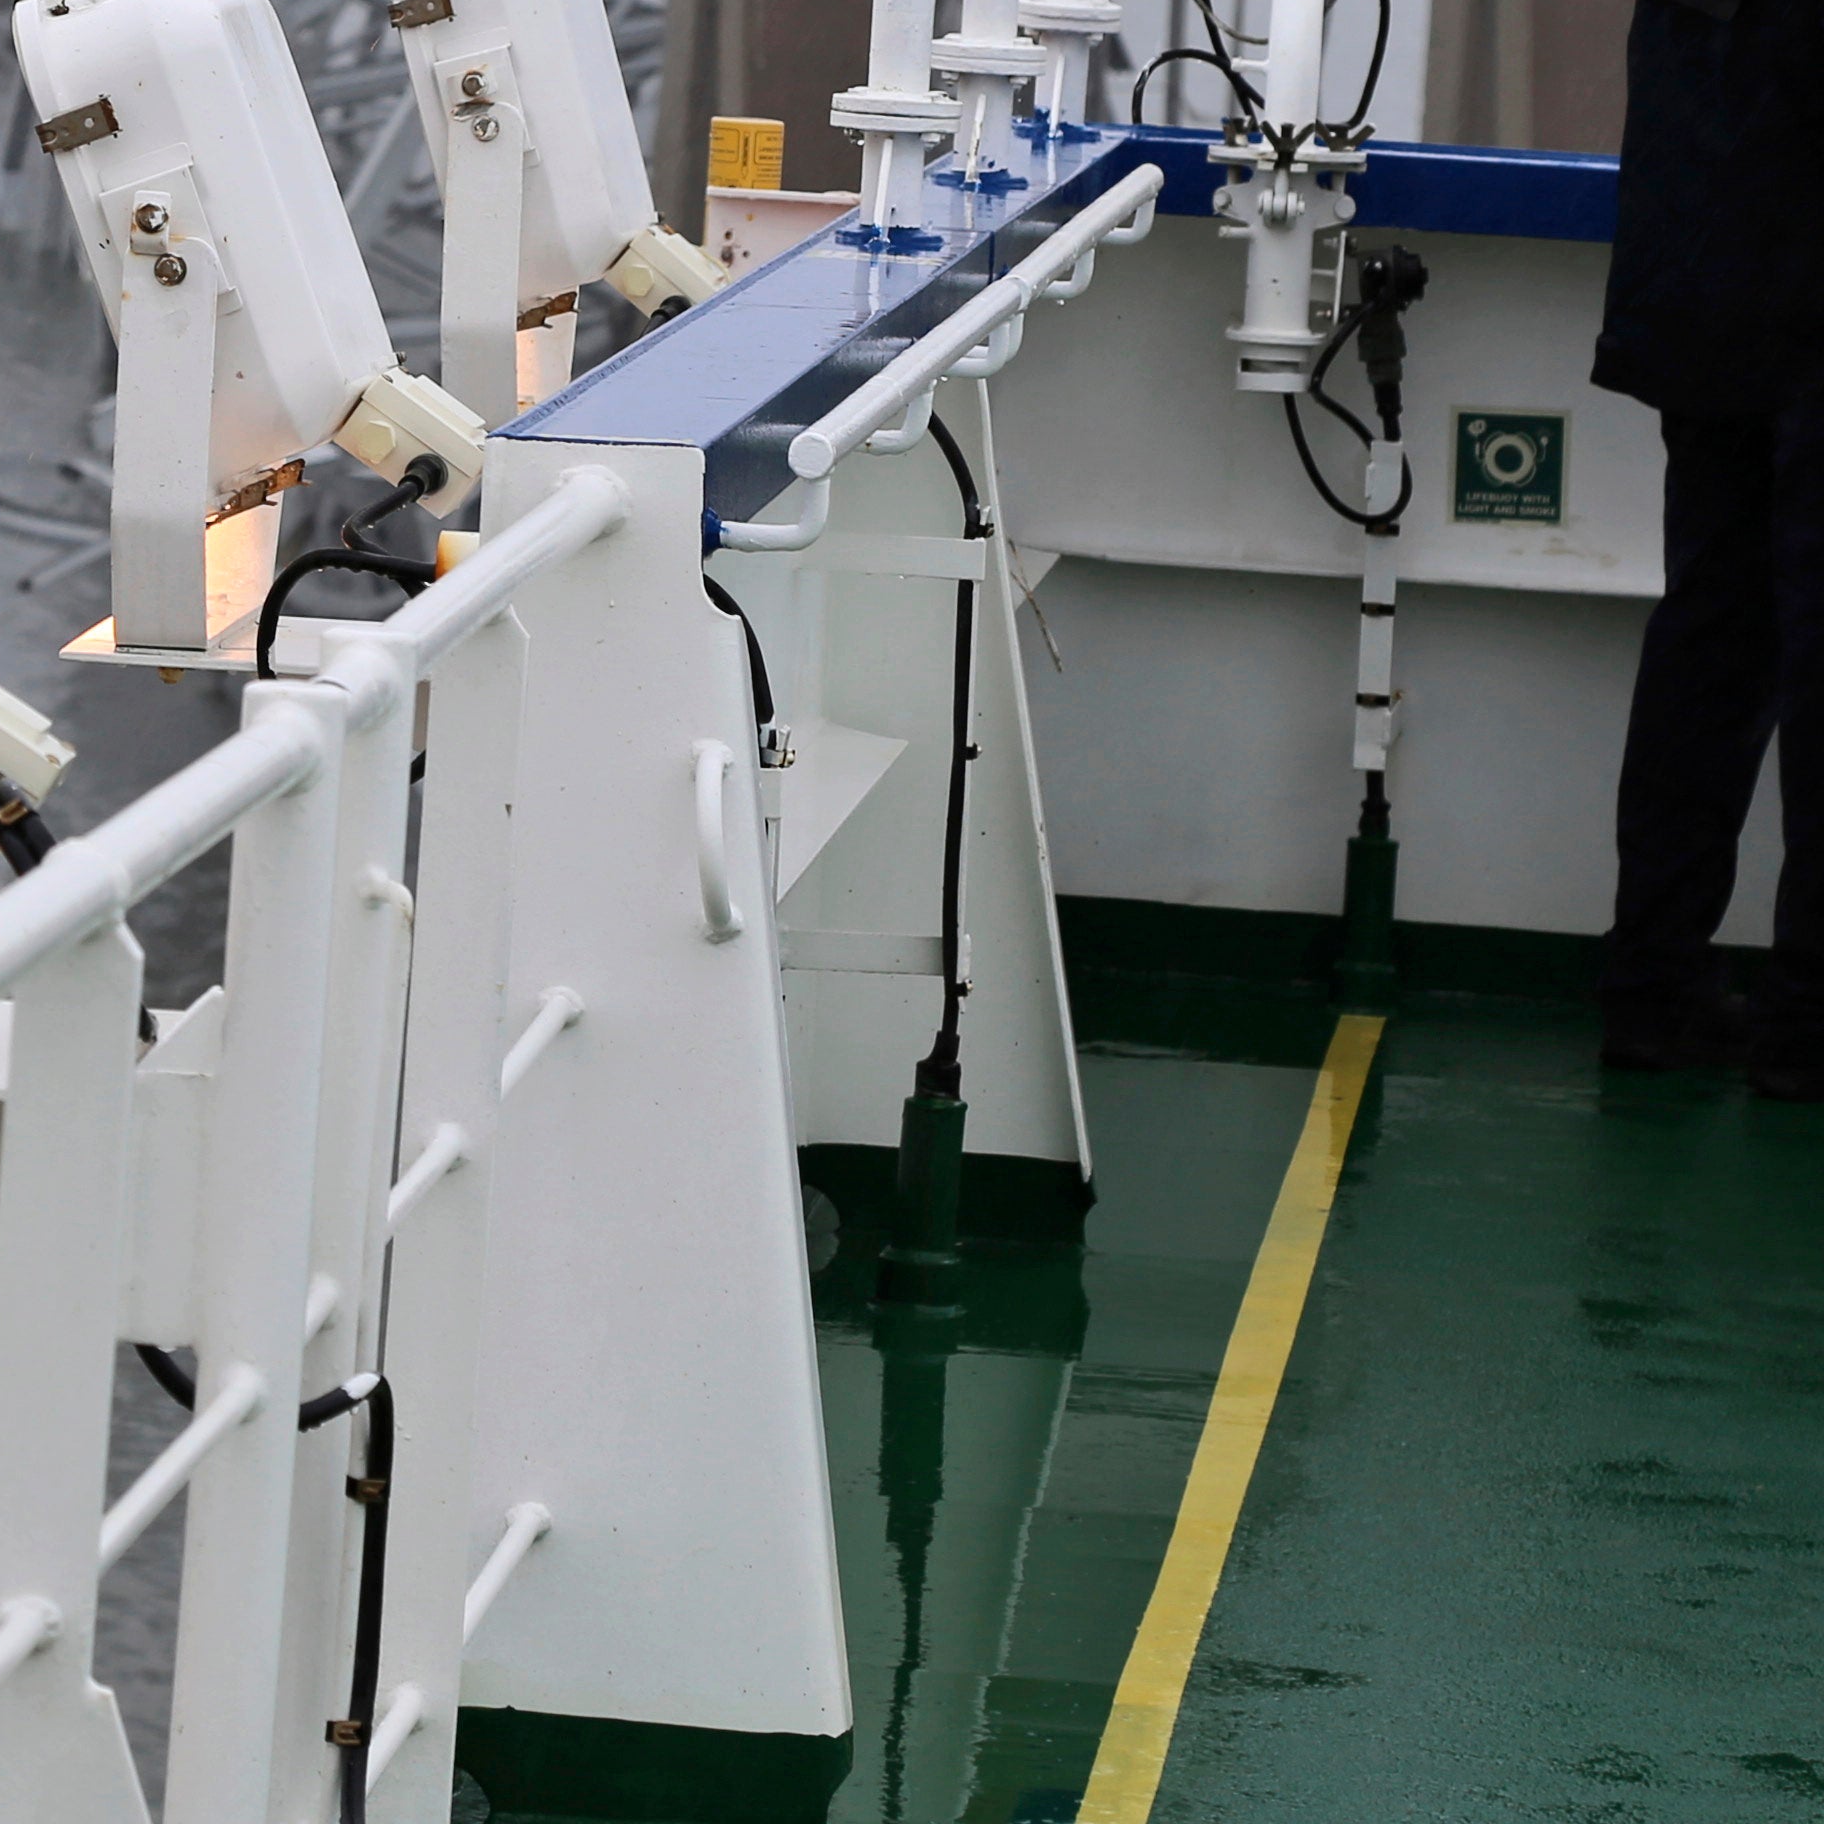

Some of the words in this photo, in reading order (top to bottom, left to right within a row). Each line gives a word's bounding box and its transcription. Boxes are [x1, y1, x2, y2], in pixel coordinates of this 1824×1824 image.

[1466, 490, 1519, 503] LIFEBUOY
[1522, 493, 1551, 504] WITH
[1458, 503, 1490, 513] LIGHT
[1493, 504, 1516, 514] AND
[1519, 505, 1556, 516] SMOKE
